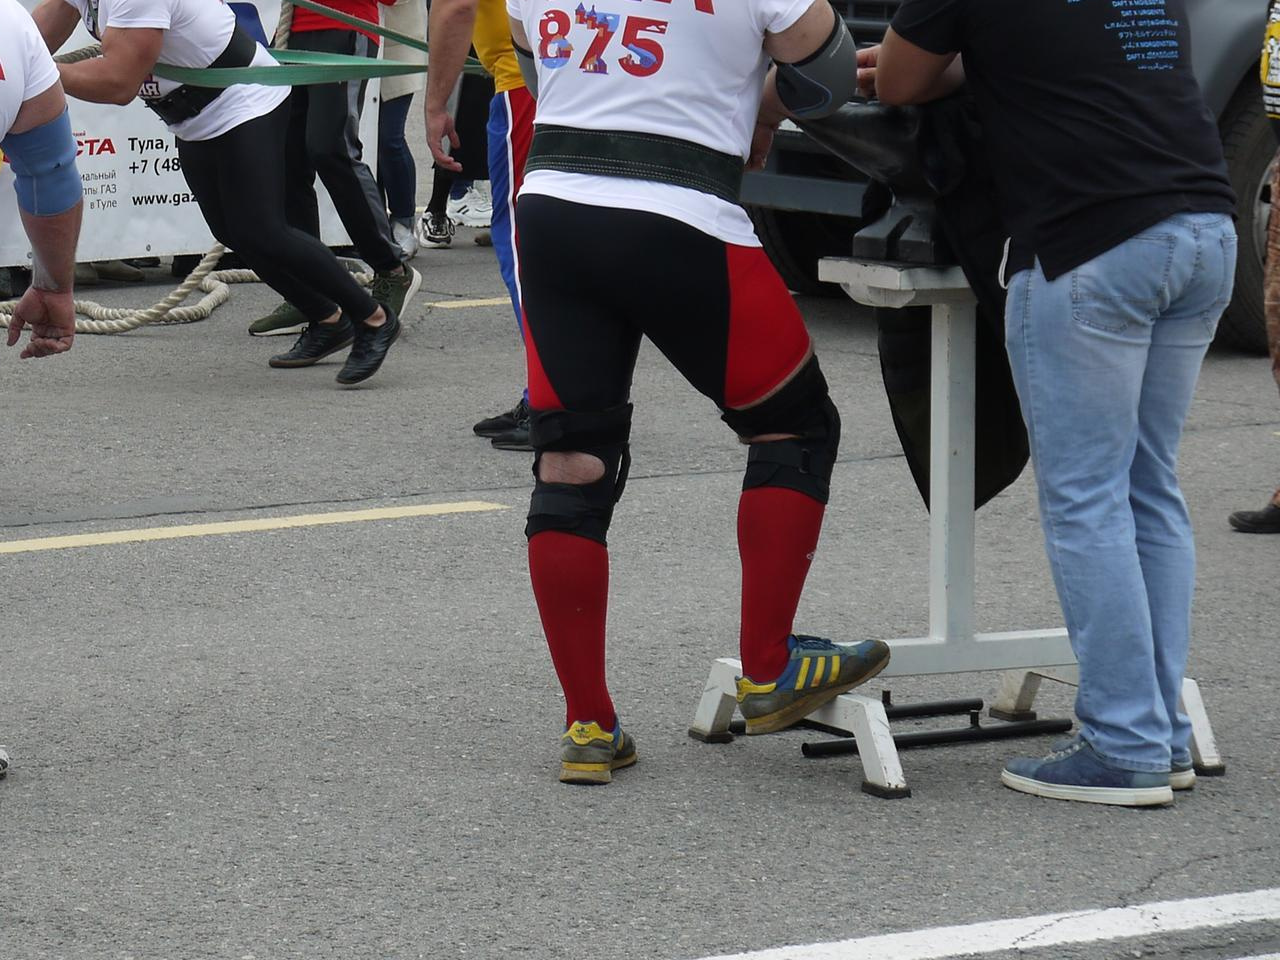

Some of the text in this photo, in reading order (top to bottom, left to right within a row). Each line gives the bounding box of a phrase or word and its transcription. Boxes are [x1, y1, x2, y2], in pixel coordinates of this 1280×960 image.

[538, 3, 668, 77] 875
[128, 137, 169, 154] Тула,
[129, 160, 148, 174] +7
[101, 184, 117, 194] ГАЗ
[96, 199, 117, 210] Туле
